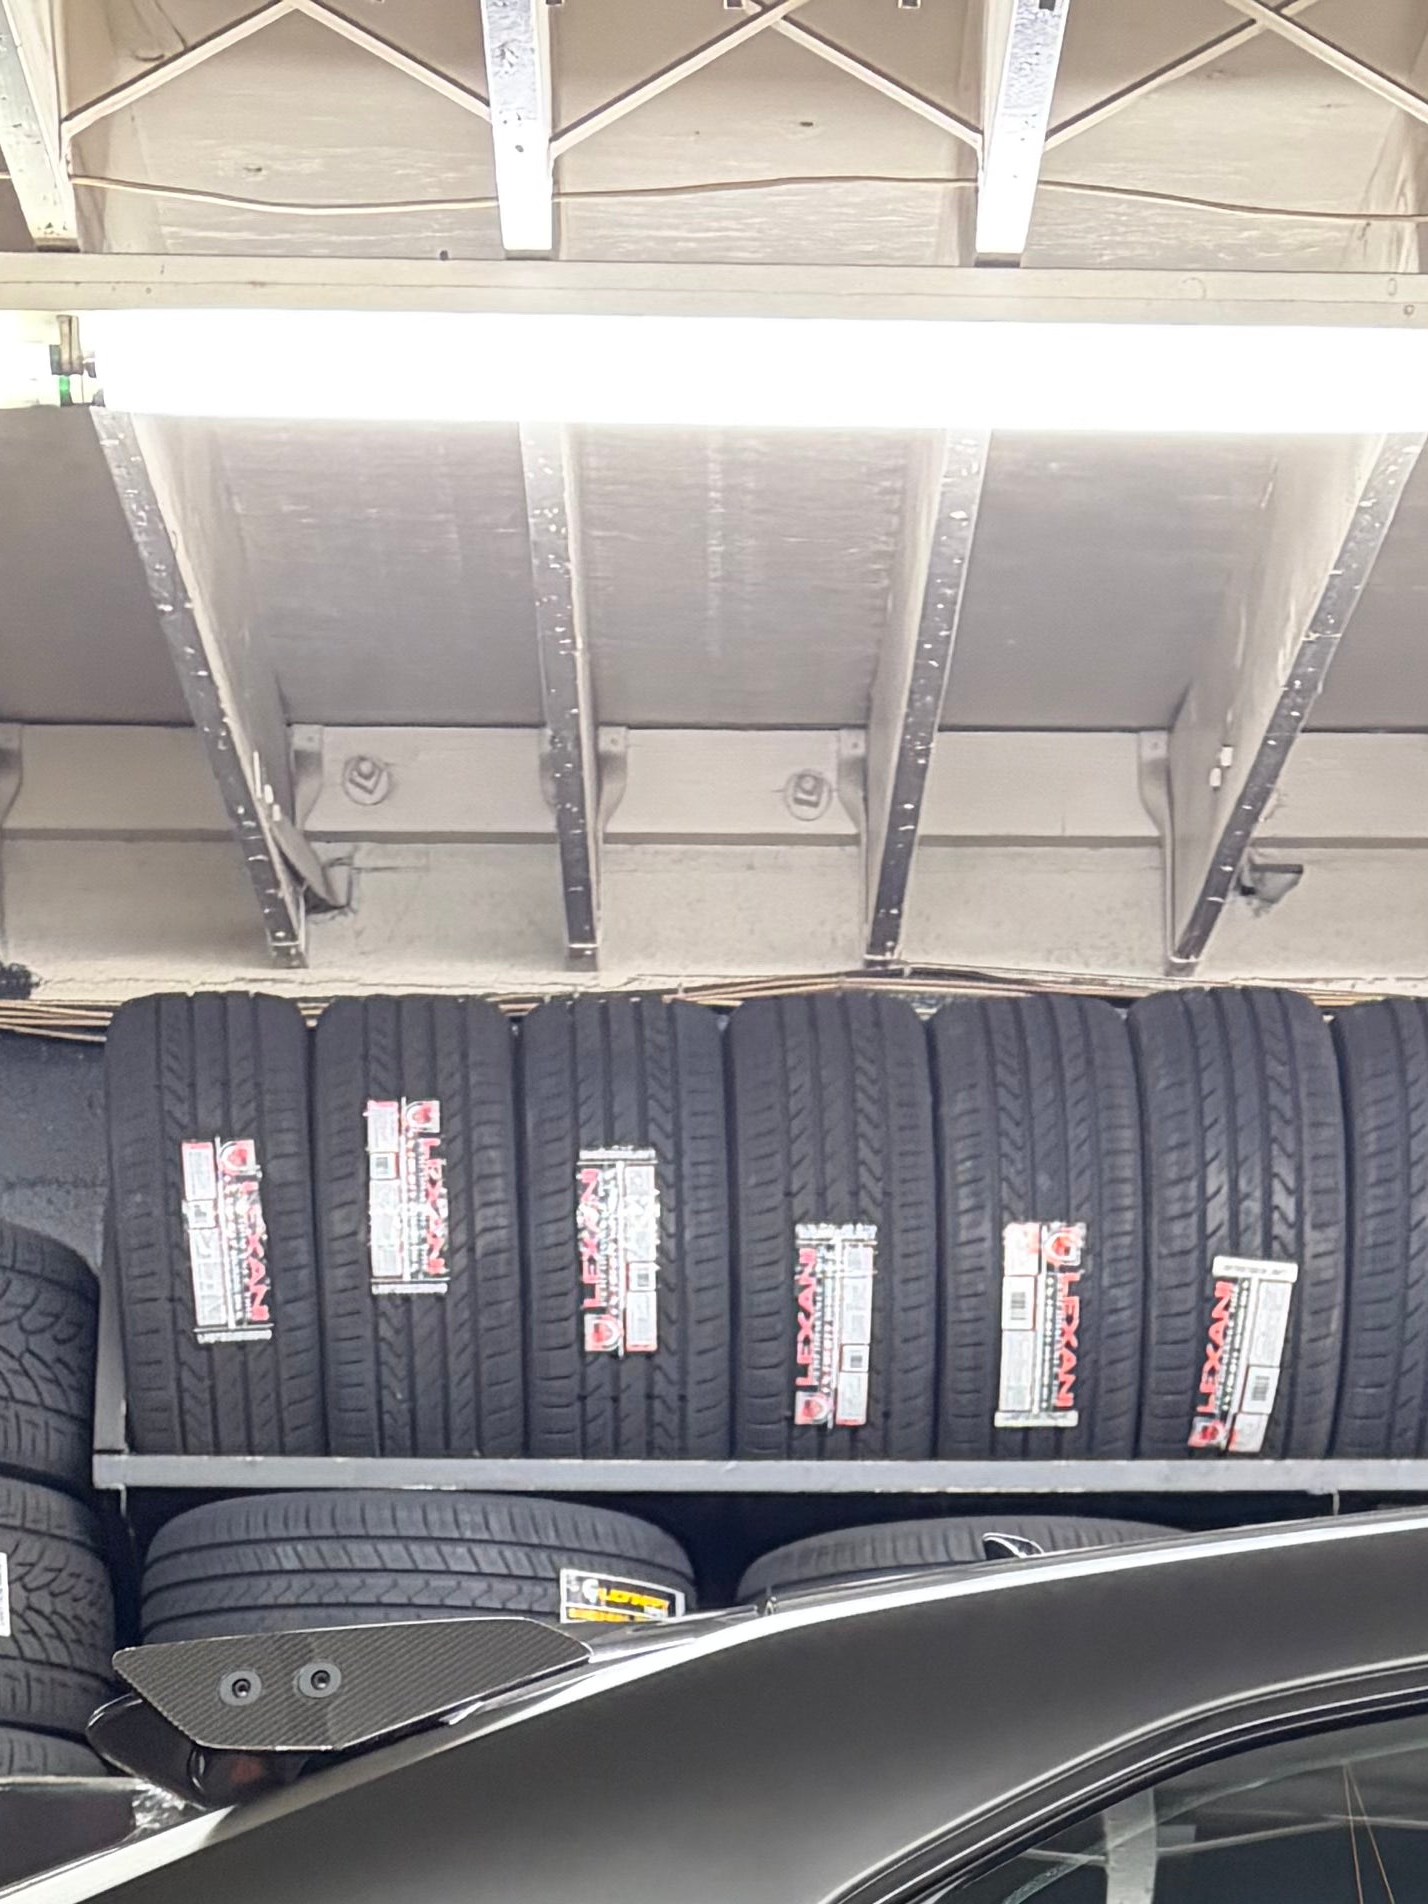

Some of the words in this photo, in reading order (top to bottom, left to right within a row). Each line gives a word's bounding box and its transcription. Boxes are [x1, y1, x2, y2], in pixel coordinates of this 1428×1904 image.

[795, 1248, 817, 1387] LEXANI
[1056, 1272, 1081, 1408] LEXANI
[1196, 1280, 1237, 1414] LEXANI
